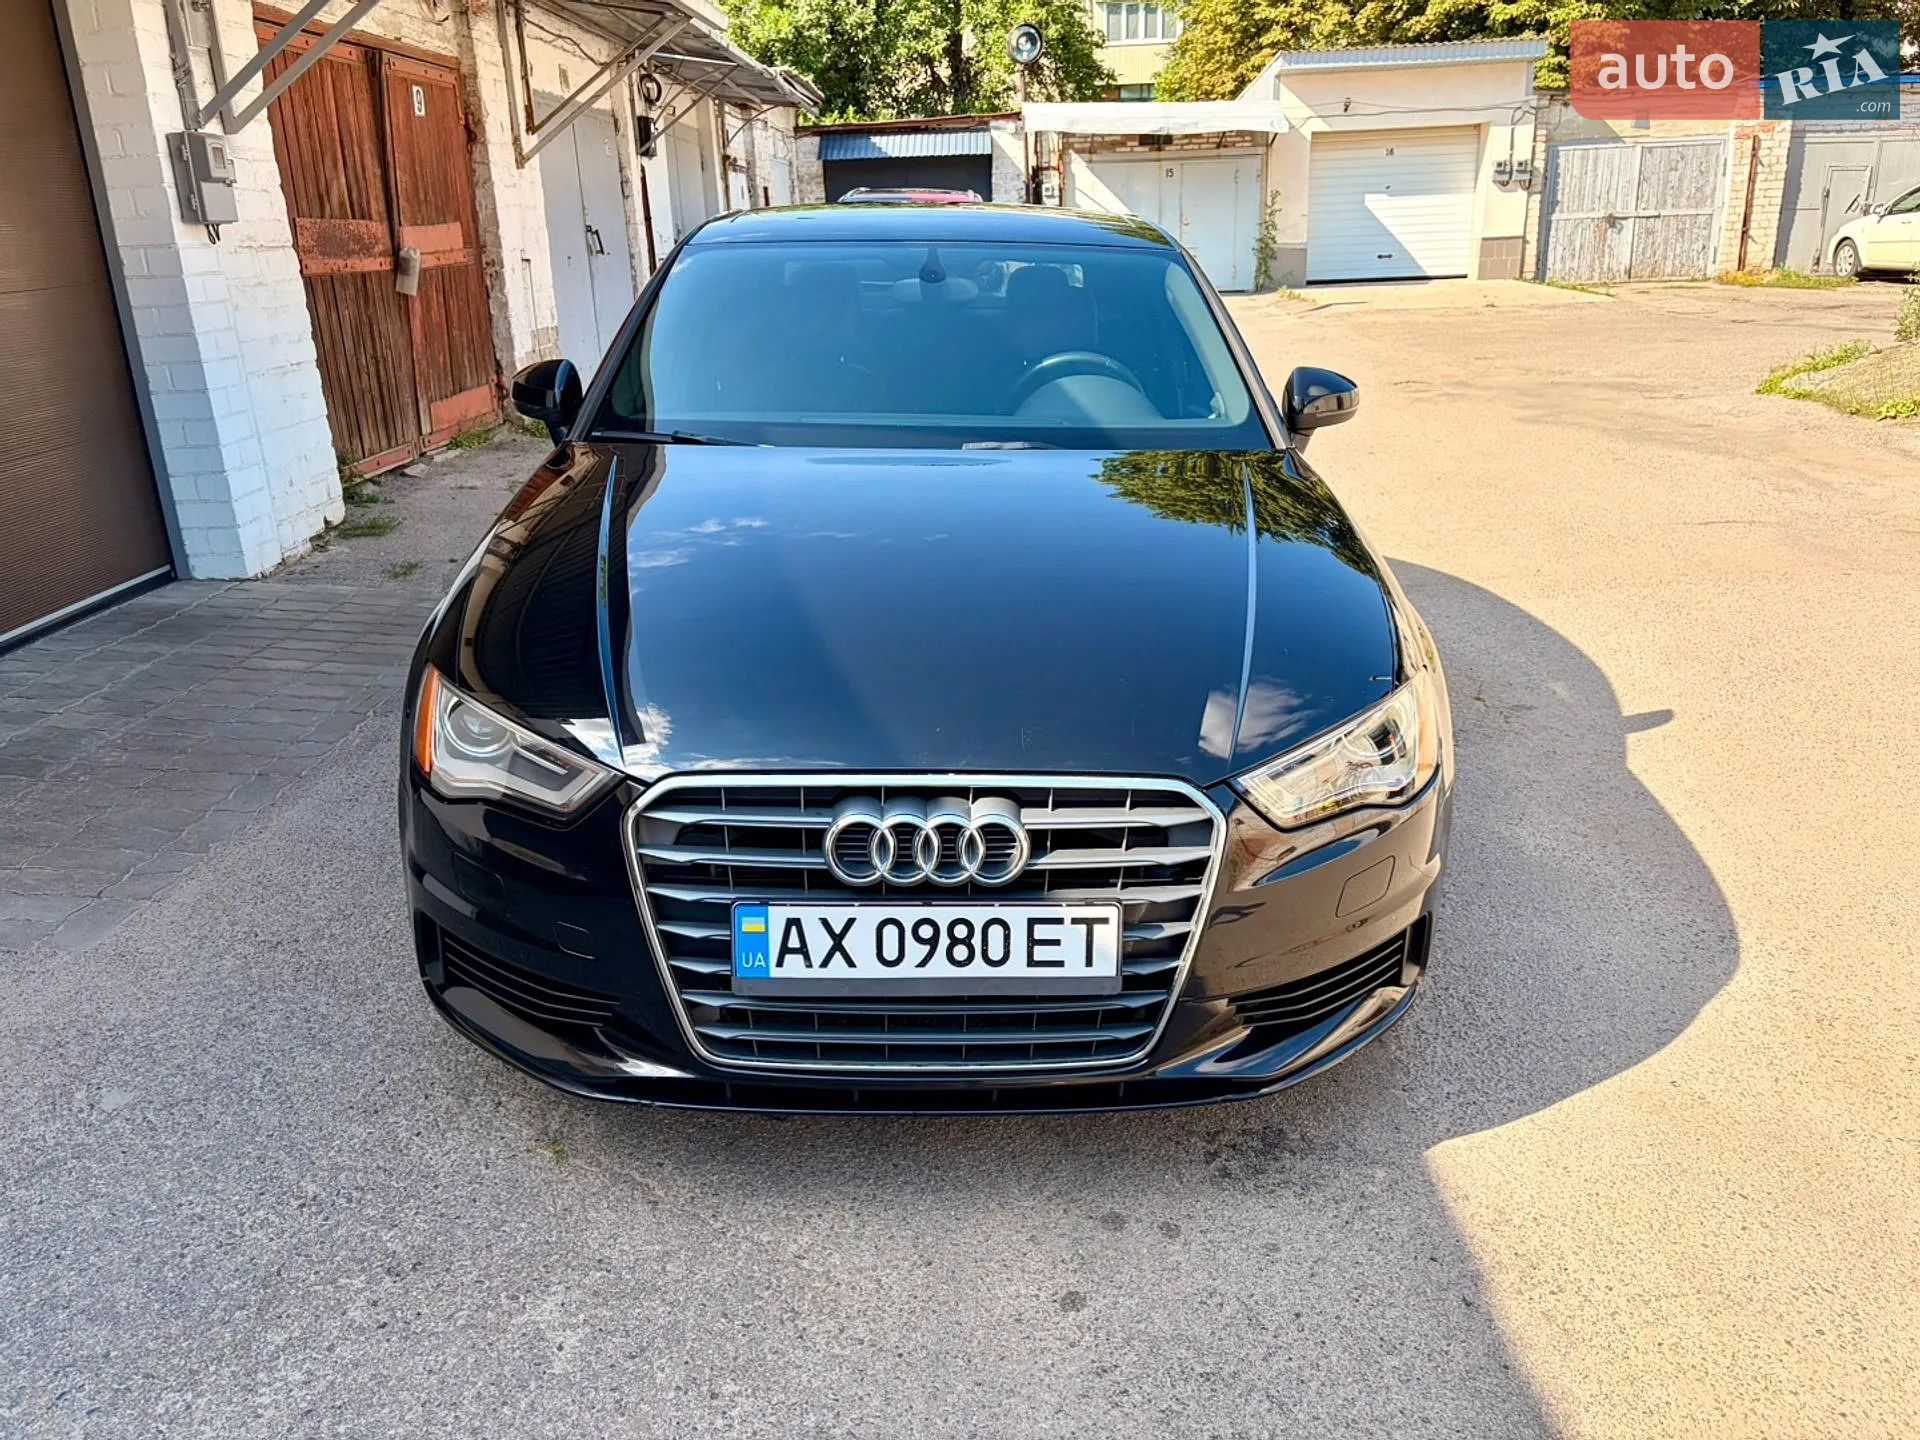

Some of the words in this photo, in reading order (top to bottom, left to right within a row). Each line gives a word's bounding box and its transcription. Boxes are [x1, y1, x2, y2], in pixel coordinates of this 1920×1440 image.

[415, 88, 423, 113] 9
[1165, 167, 1175, 179] 15
[775, 917, 857, 968] AX
[875, 917, 1011, 968] 0980
[1026, 917, 1110, 968] ET
[742, 952, 767, 968] UA
